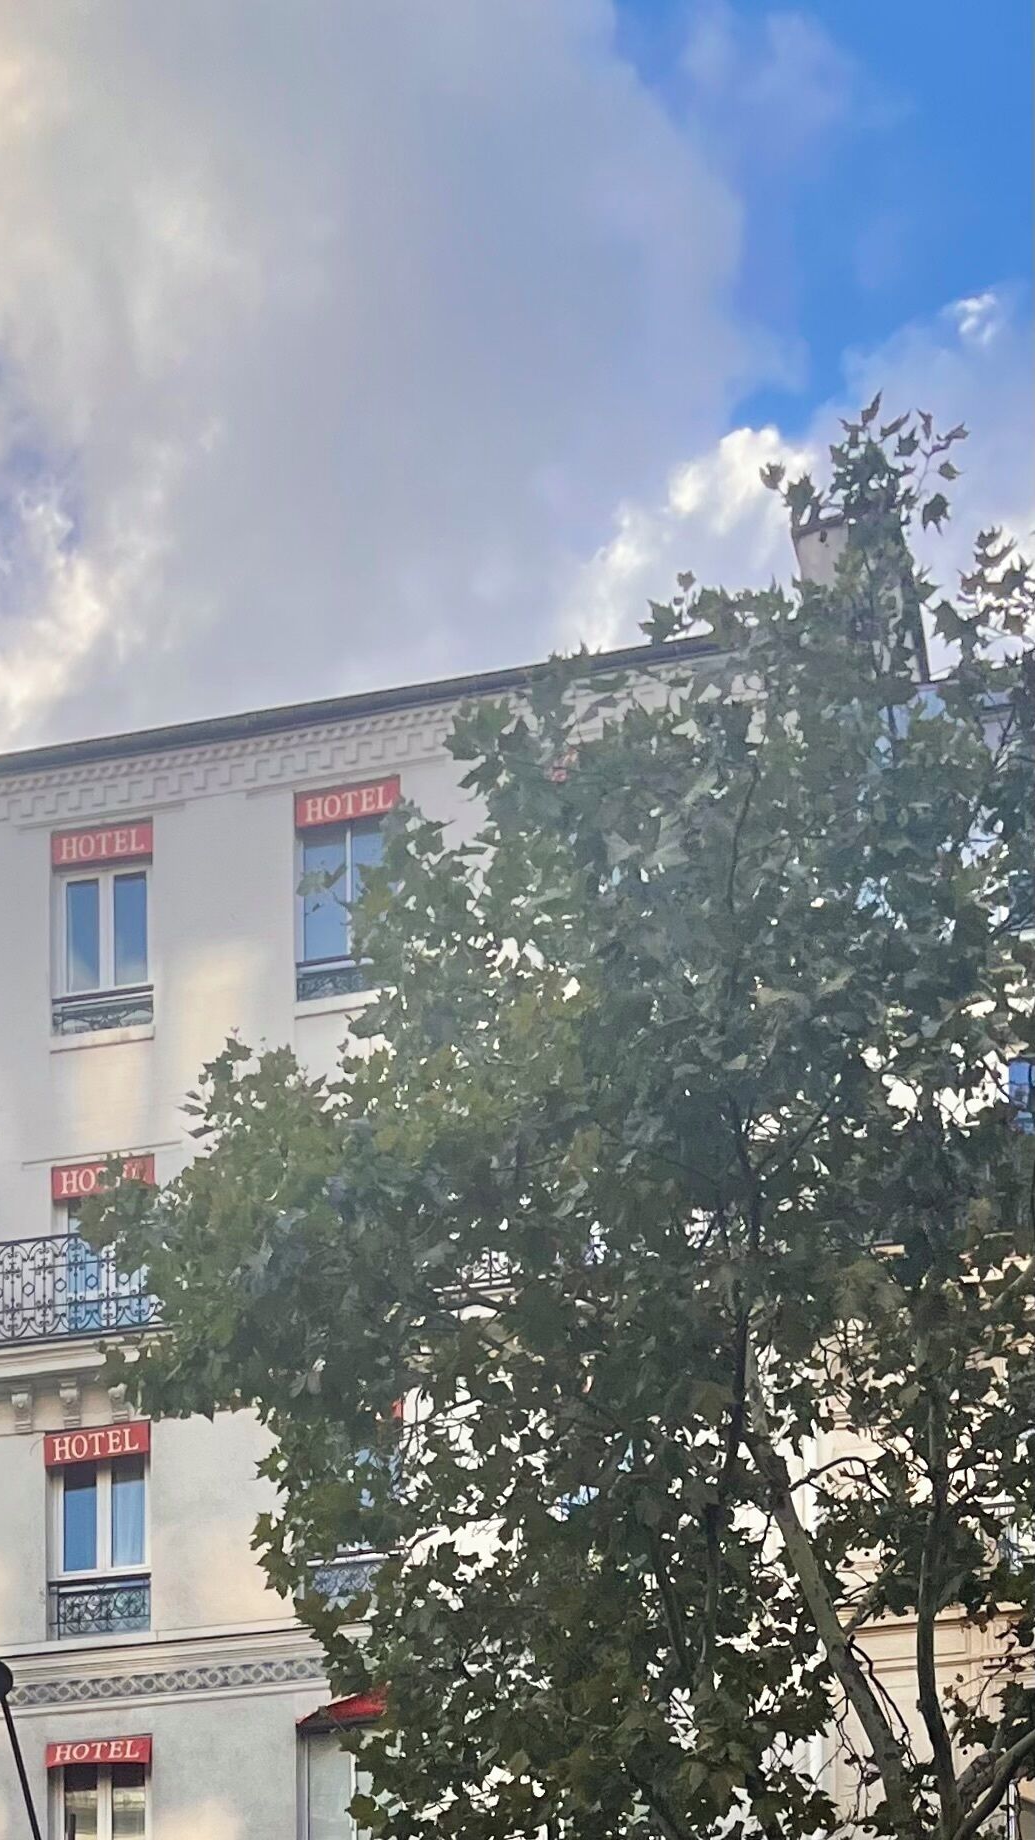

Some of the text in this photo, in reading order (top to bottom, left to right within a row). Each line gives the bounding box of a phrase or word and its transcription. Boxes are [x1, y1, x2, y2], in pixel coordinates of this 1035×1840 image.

[305, 786, 394, 822] HOTEL
[60, 828, 144, 860] HOTEL
[53, 1428, 139, 1462] HOTEL
[55, 1741, 140, 1761] HOTEL
